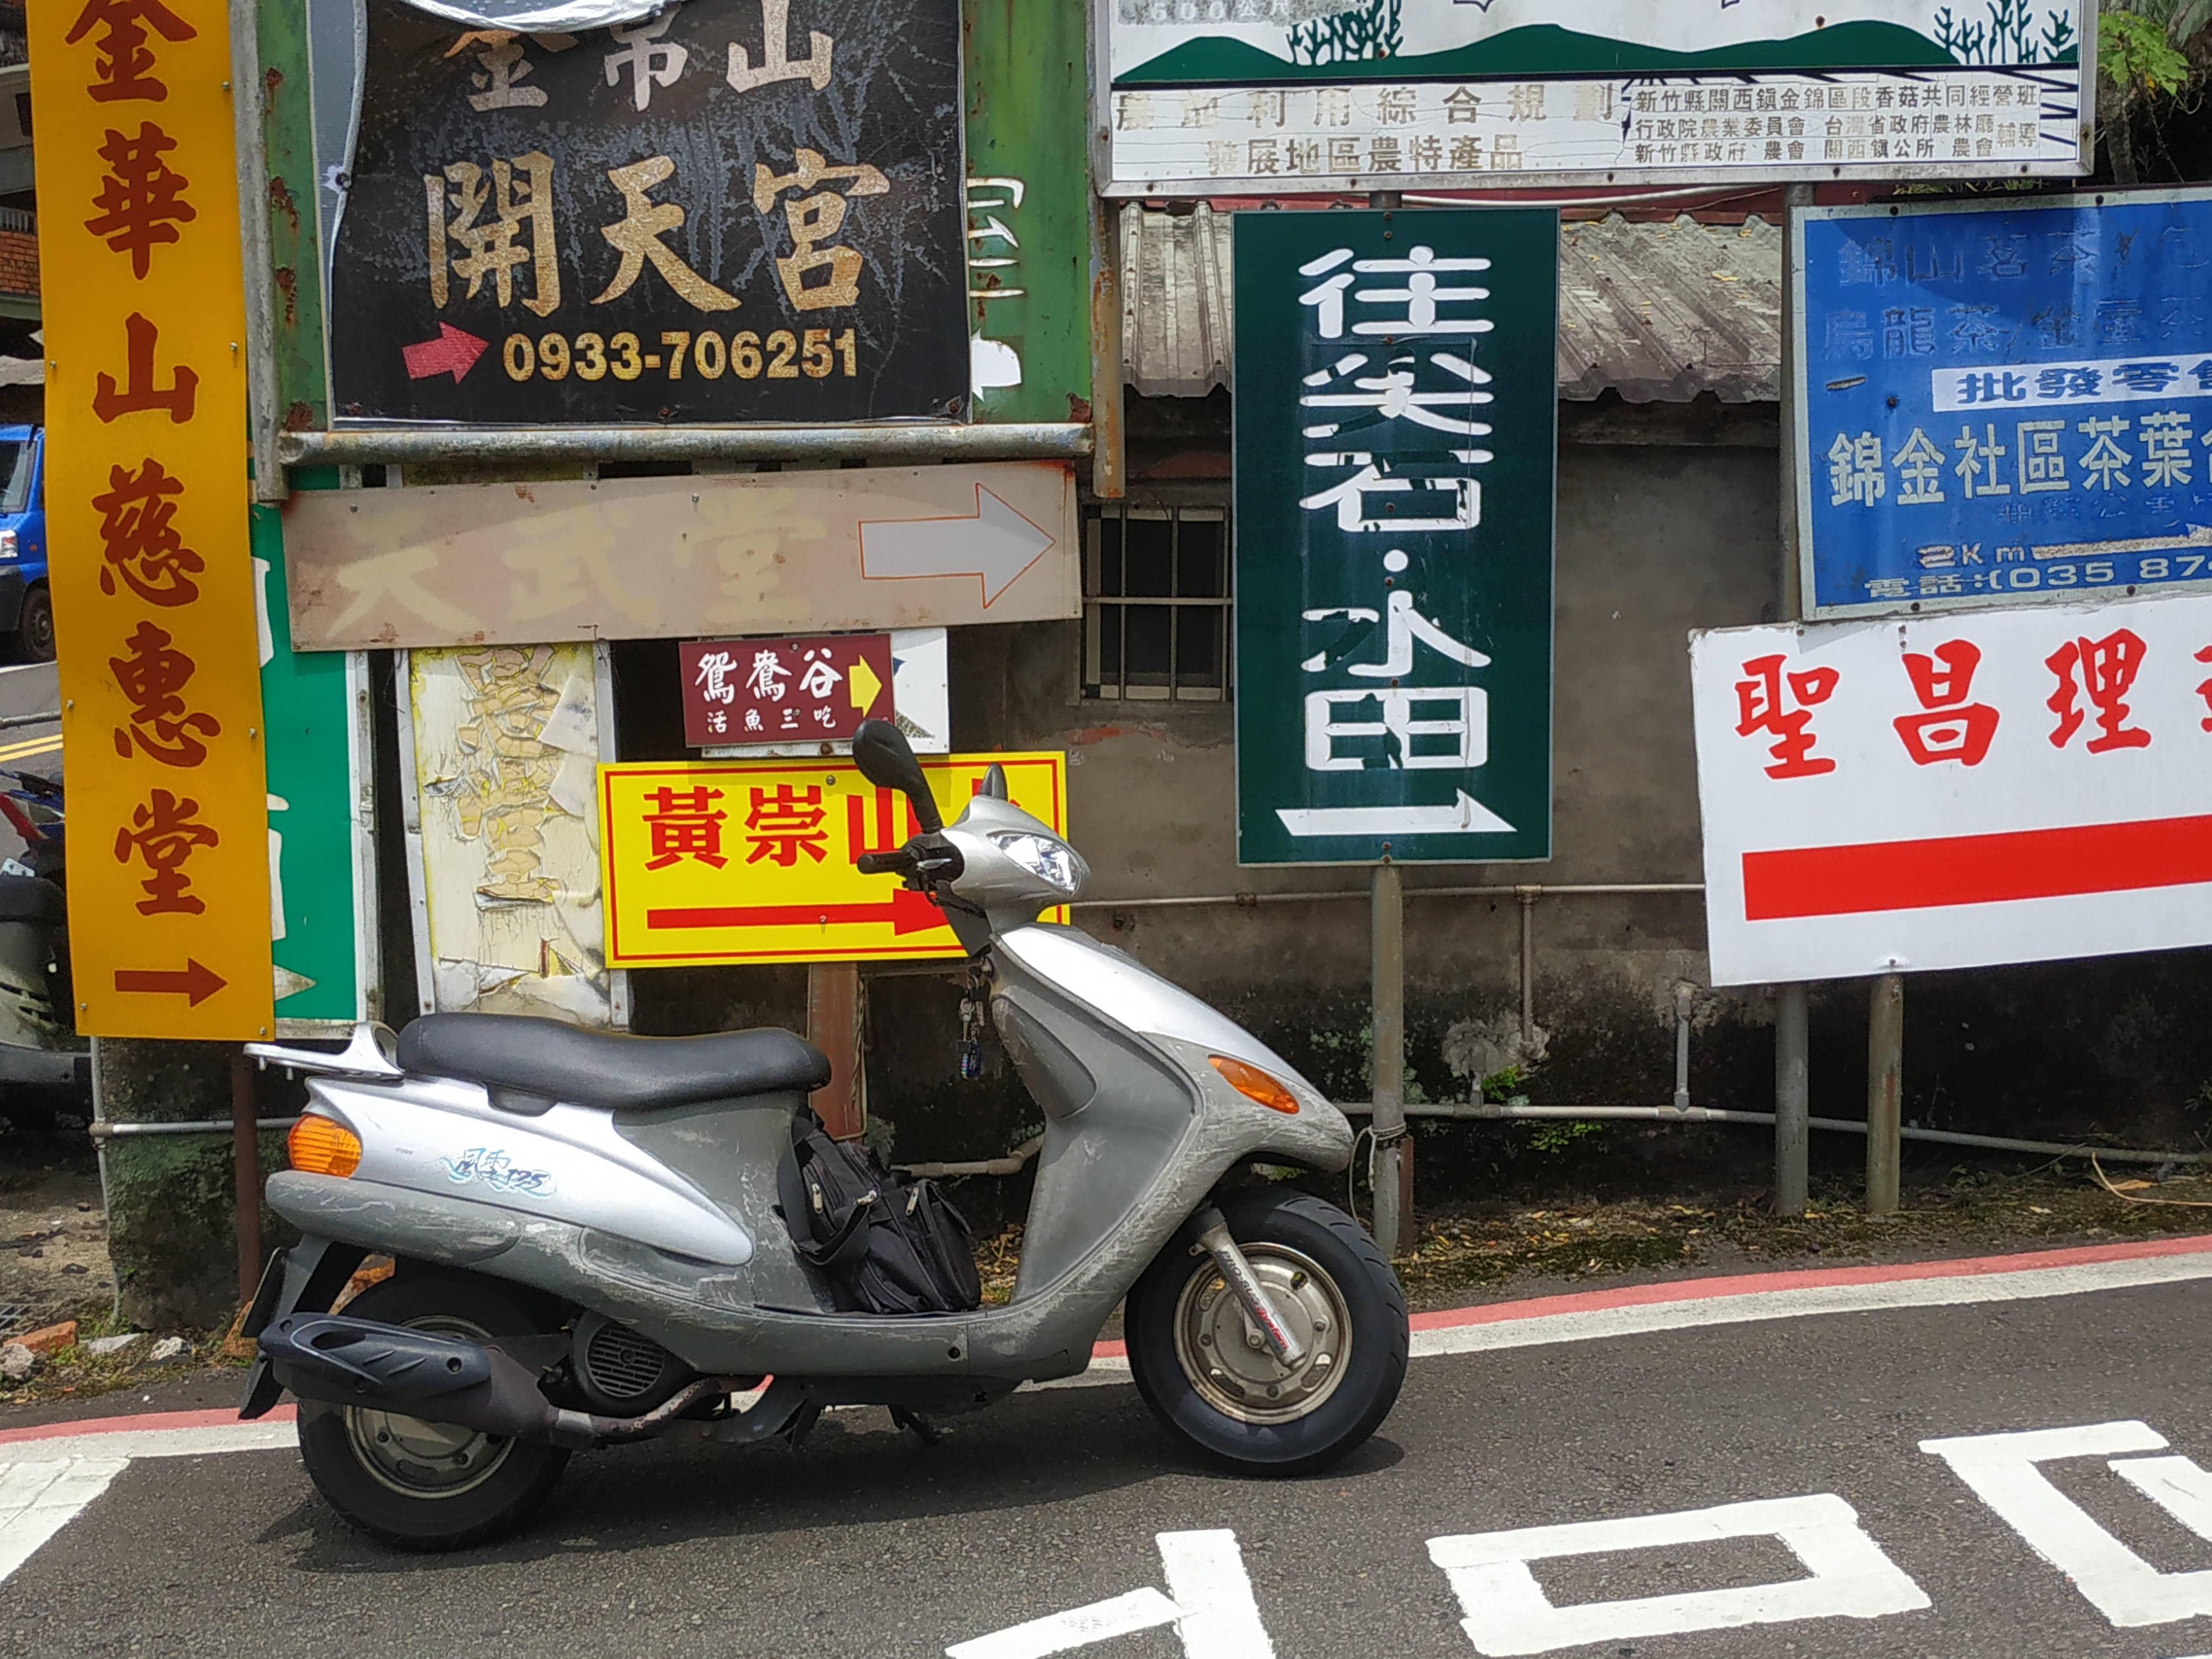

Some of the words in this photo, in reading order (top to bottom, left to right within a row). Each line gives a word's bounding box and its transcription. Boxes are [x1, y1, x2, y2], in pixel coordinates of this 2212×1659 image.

[1635, 116, 1806, 140] 行政院農業委員會
[423, 148, 889, 317] 開天宮
[503, 328, 858, 382] 0933-706251
[65, 0, 221, 917] 金華山慈惠堂
[1827, 410, 2212, 507] 錦金社區茶葉
[2139, 555, 2212, 580] 87
[695, 648, 843, 705] 鴛鴦谷
[1734, 627, 2212, 779] 聖昌理
[707, 705, 836, 733] 活魚三吃
[642, 778, 1021, 871] 黃崇山
